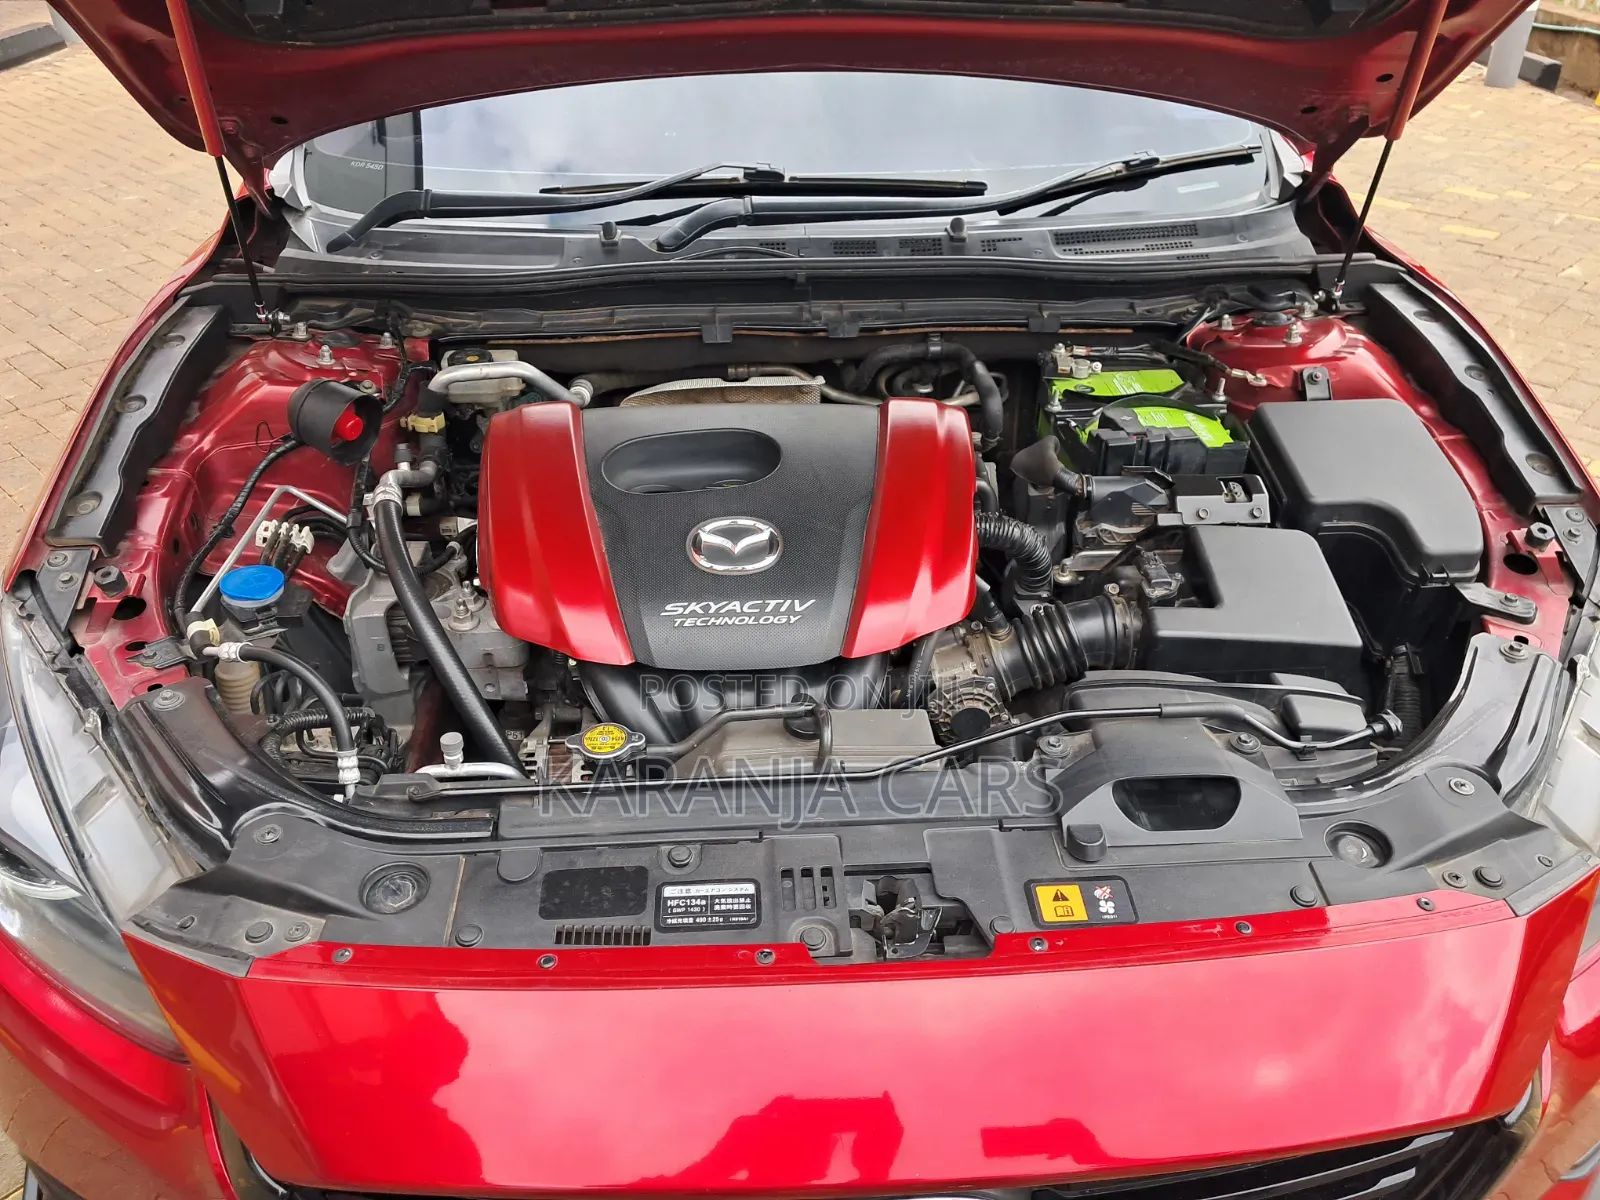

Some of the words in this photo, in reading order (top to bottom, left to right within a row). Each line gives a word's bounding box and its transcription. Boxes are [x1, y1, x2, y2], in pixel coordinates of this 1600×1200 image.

[350, 160, 366, 168] KDR
[660, 599, 816, 616] SKYACTIV
[673, 615, 802, 628] TECHNOLOGY
[667, 898, 706, 907] HFC134a
